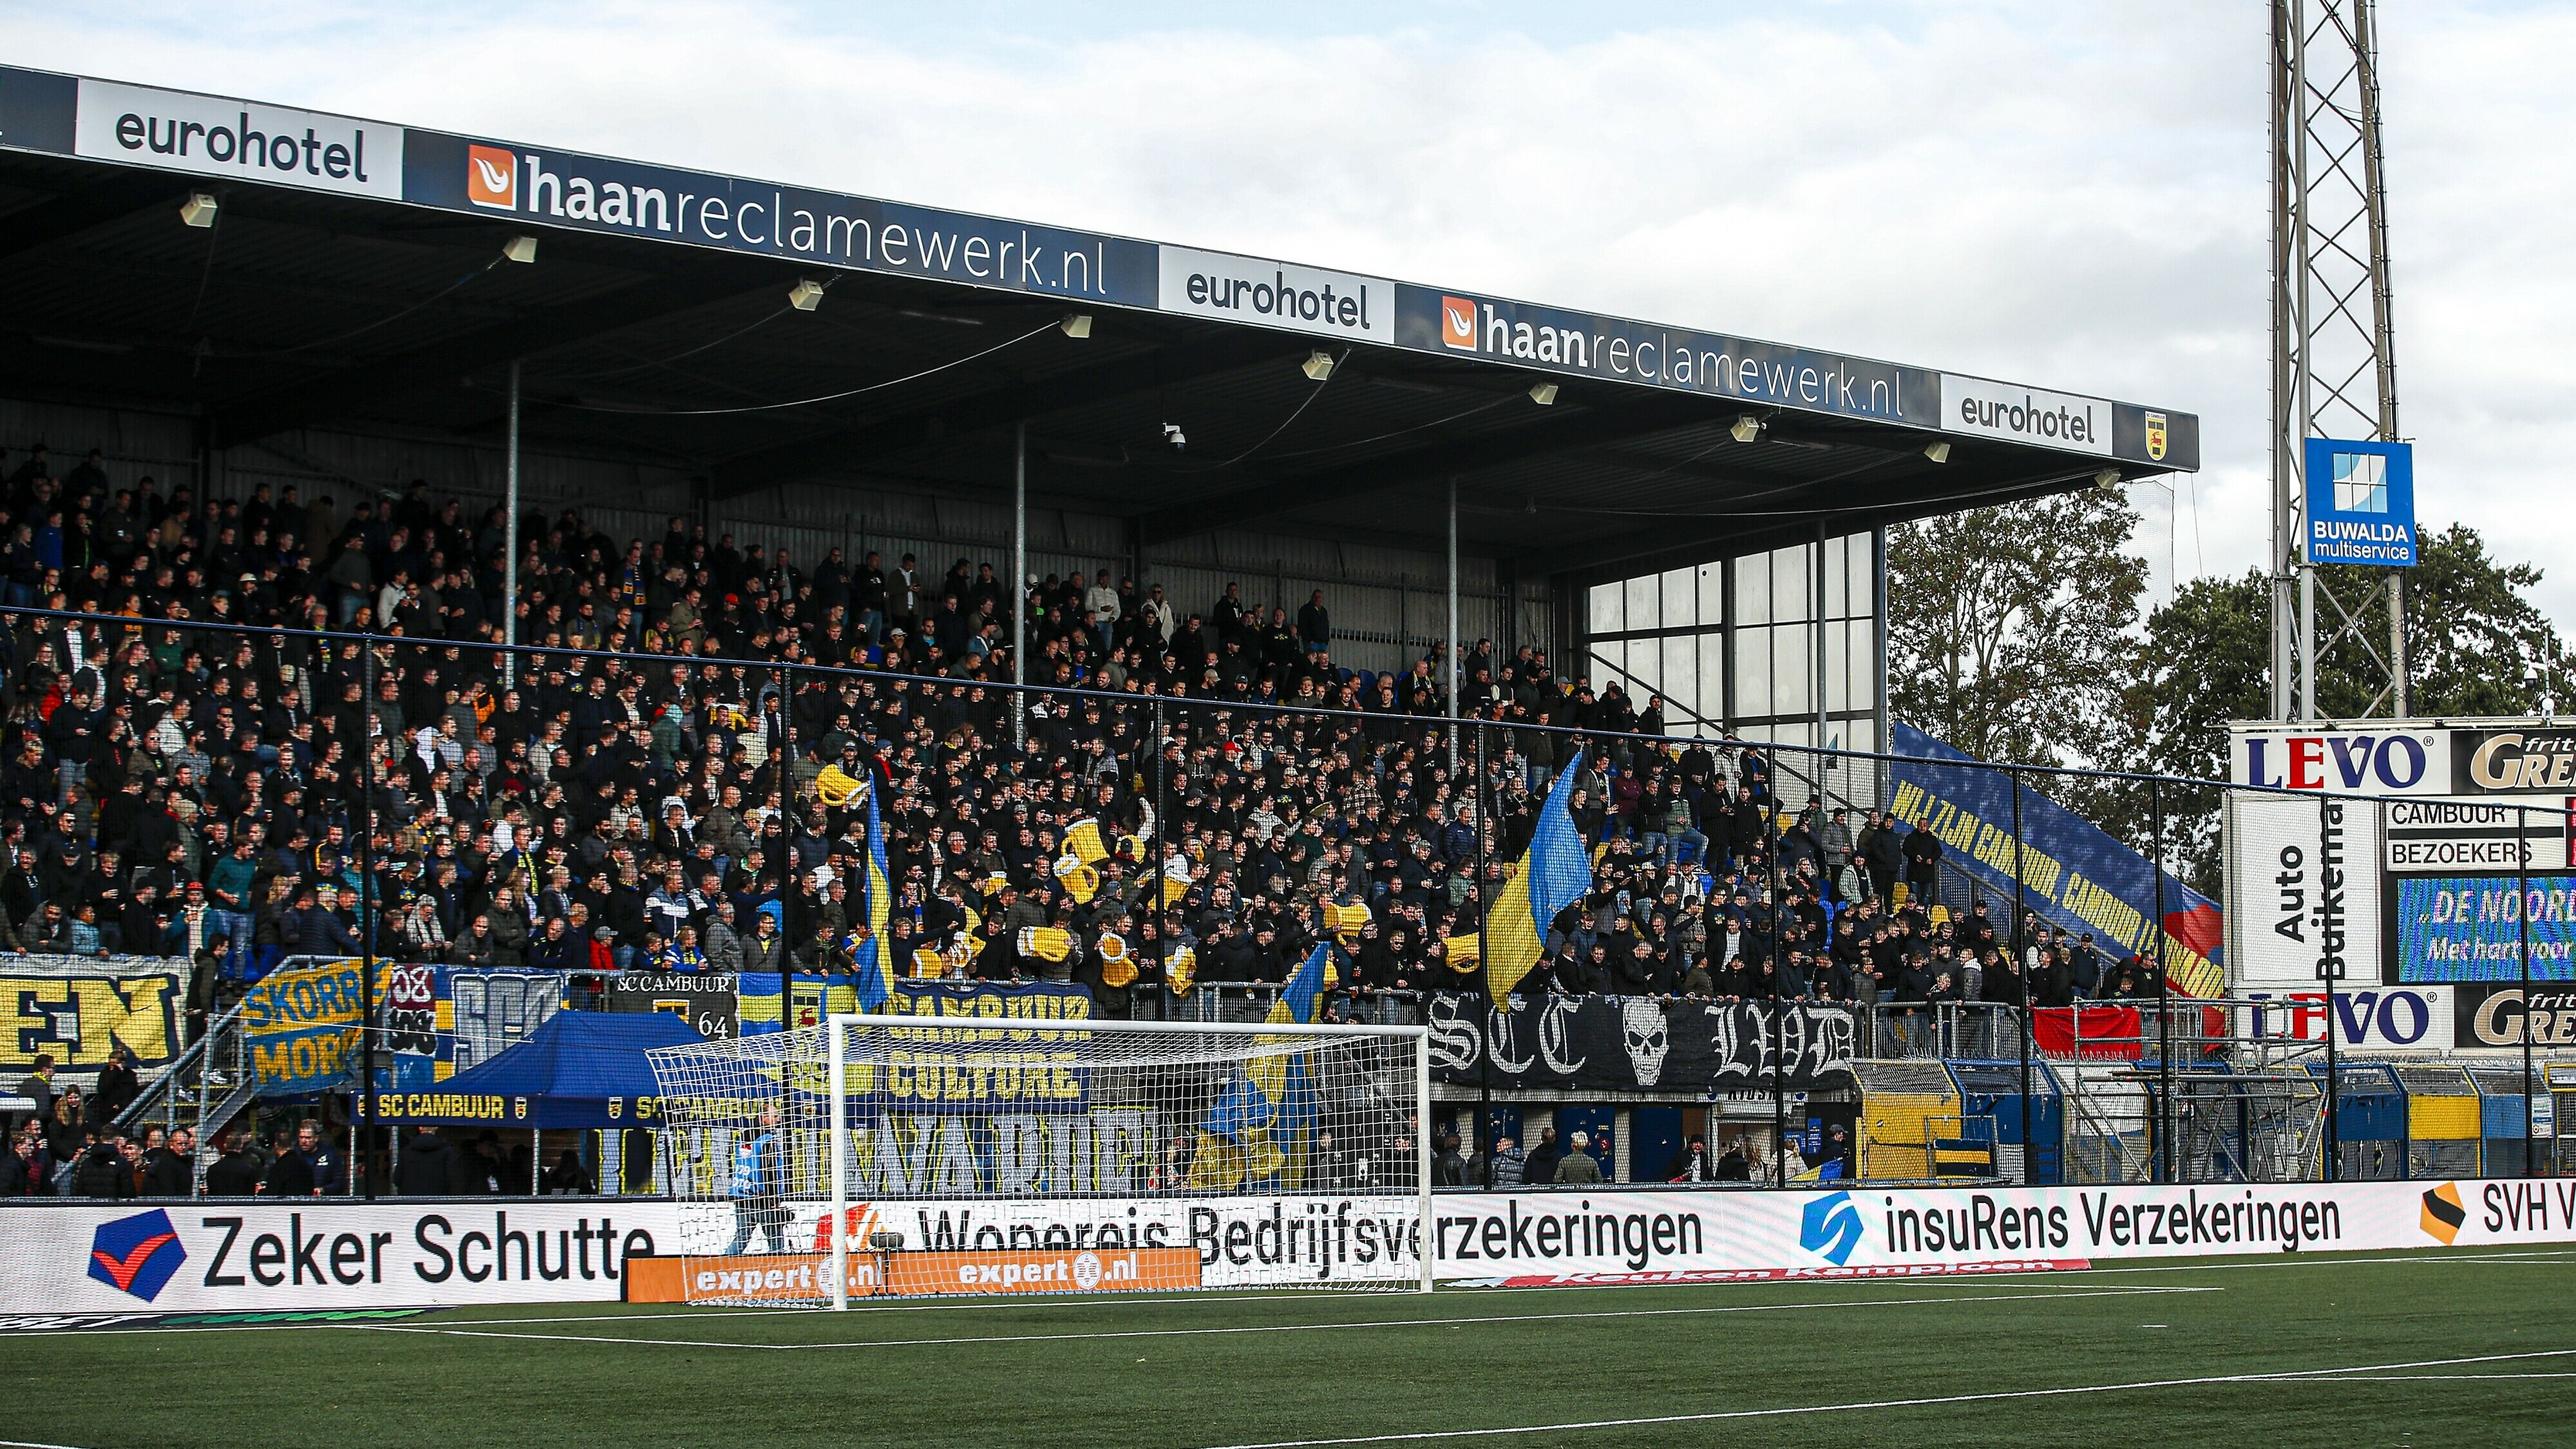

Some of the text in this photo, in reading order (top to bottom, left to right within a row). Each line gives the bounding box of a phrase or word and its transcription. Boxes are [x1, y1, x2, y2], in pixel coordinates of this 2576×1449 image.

[116, 112, 368, 183] eurohotel
[526, 155, 1106, 295] haanreclamewerk.nl
[1187, 270, 1370, 330] eurohotel
[1483, 303, 1903, 417] haanreclamewerk.nl
[1961, 395, 2095, 444] eurohotel
[2314, 520, 2409, 543] BUWALDA
[2315, 540, 2409, 560] multiservice
[2470, 734, 2576, 789] GRE
[2392, 804, 2506, 824] CAMBUUR
[1890, 779, 1937, 829] WIJ
[1929, 799, 1981, 853] ZIJN
[2062, 871, 2142, 951] CAMBUUR
[2392, 841, 2532, 864] BEZOEKERS
[2275, 846, 2305, 943] Auto
[2311, 803, 2345, 980] Buikema
[2428, 936, 2470, 961] Met
[2474, 935, 2522, 960] hart
[617, 975, 730, 992] SC CAMBUUR
[2474, 989, 2576, 1045] GRE
[887, 1050, 1080, 1101] CULTURE
[378, 1094, 504, 1119] SC CAMBUUR
[1886, 1189, 2341, 1253] insuRens Verzekeringen
[2483, 1182, 2548, 1233] SVH
[202, 1211, 656, 1287] Zeker Schutte
[1189, 1199, 1703, 1279] Bedrijfsverzekeringen
[696, 1264, 812, 1294] expert
[958, 1257, 1068, 1287] expert
